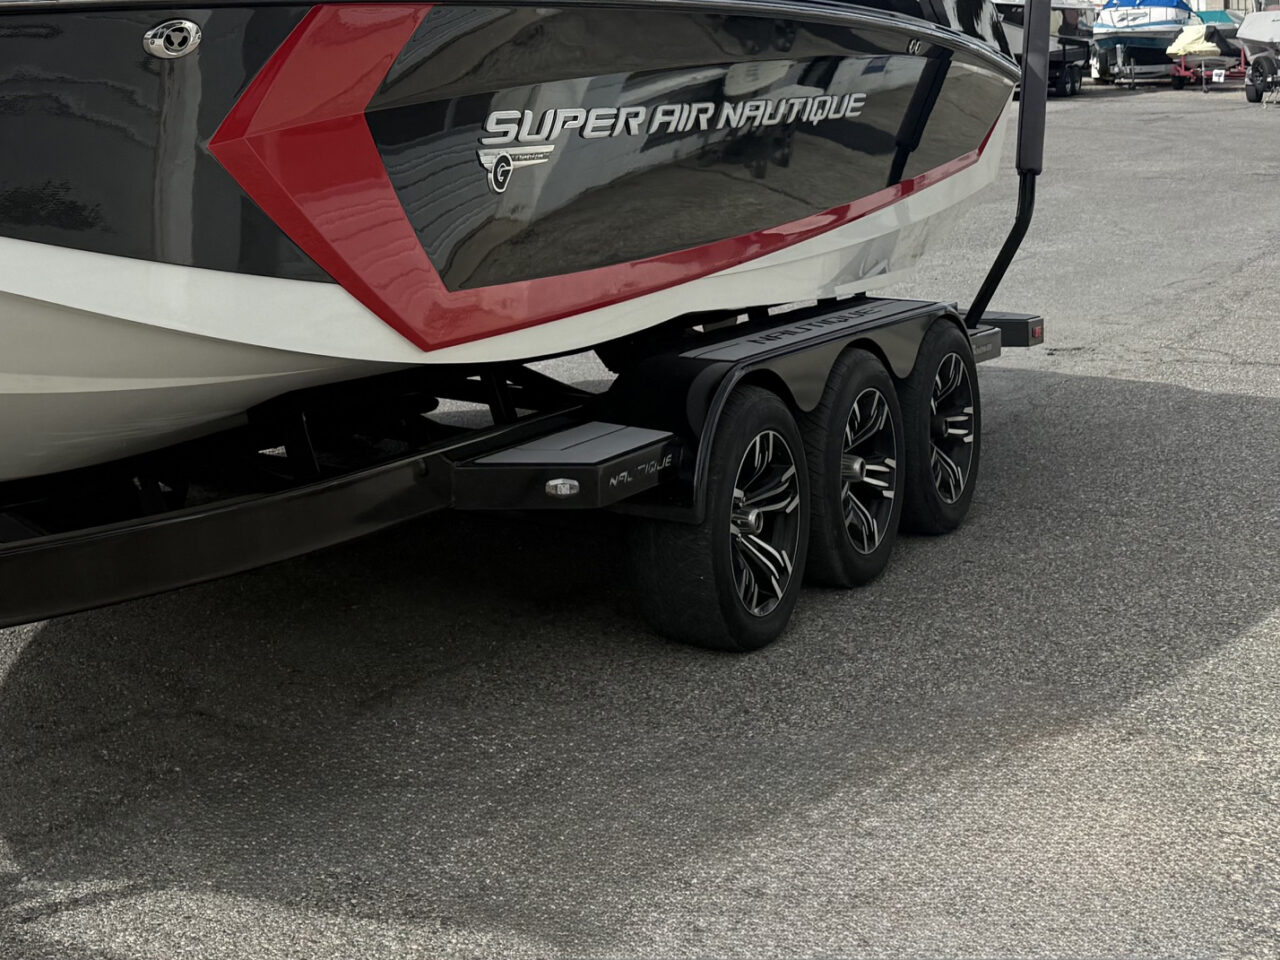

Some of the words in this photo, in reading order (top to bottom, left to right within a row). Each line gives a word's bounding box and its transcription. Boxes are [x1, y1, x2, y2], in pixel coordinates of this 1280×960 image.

[480, 106, 644, 145] SUPER
[649, 101, 716, 135] AIR
[716, 92, 867, 130] NAUTIQUE
[747, 306, 880, 345] NAUTIQUE
